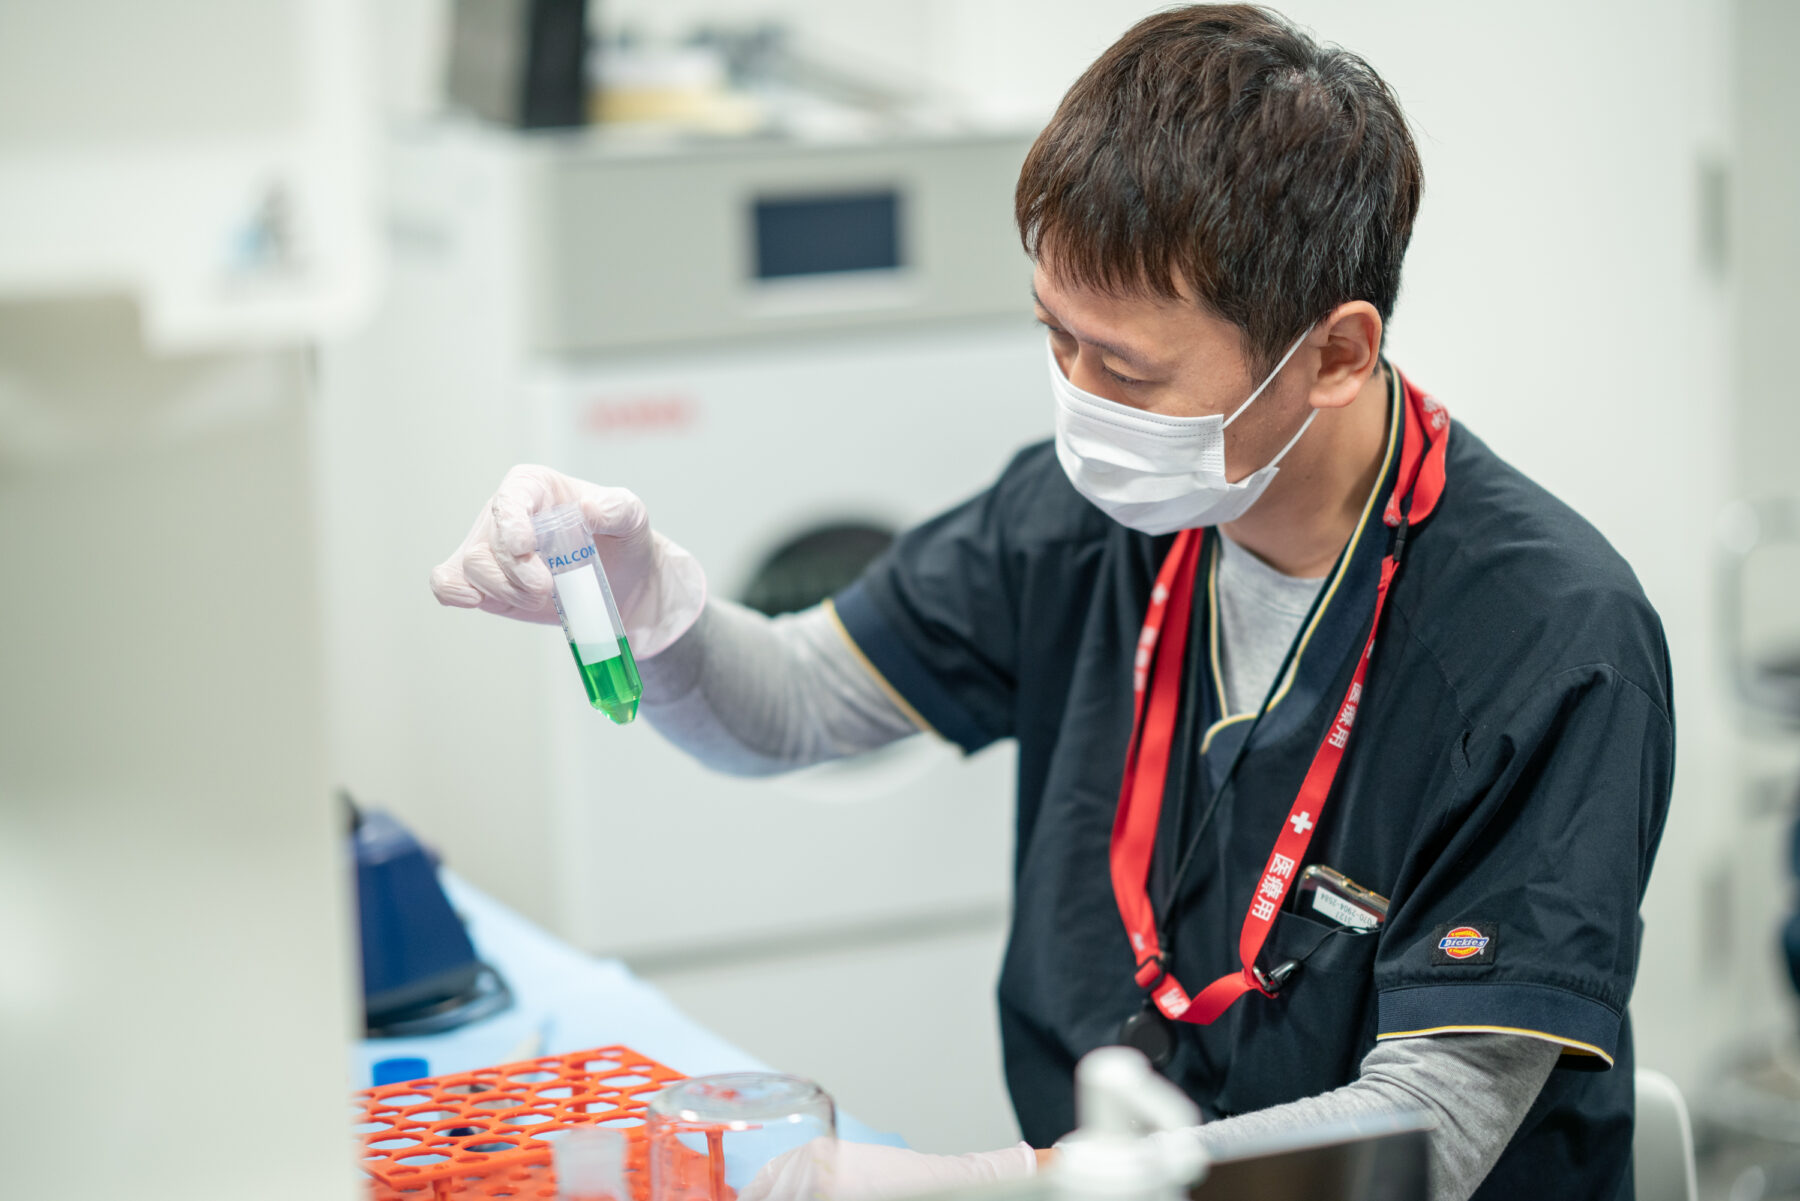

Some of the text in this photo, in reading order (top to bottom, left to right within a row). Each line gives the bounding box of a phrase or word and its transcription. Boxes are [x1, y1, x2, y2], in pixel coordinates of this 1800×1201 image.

[548, 544, 596, 569] FALCON
[1251, 852, 1295, 922] 医療用
[1444, 937, 1486, 948] Dickies
